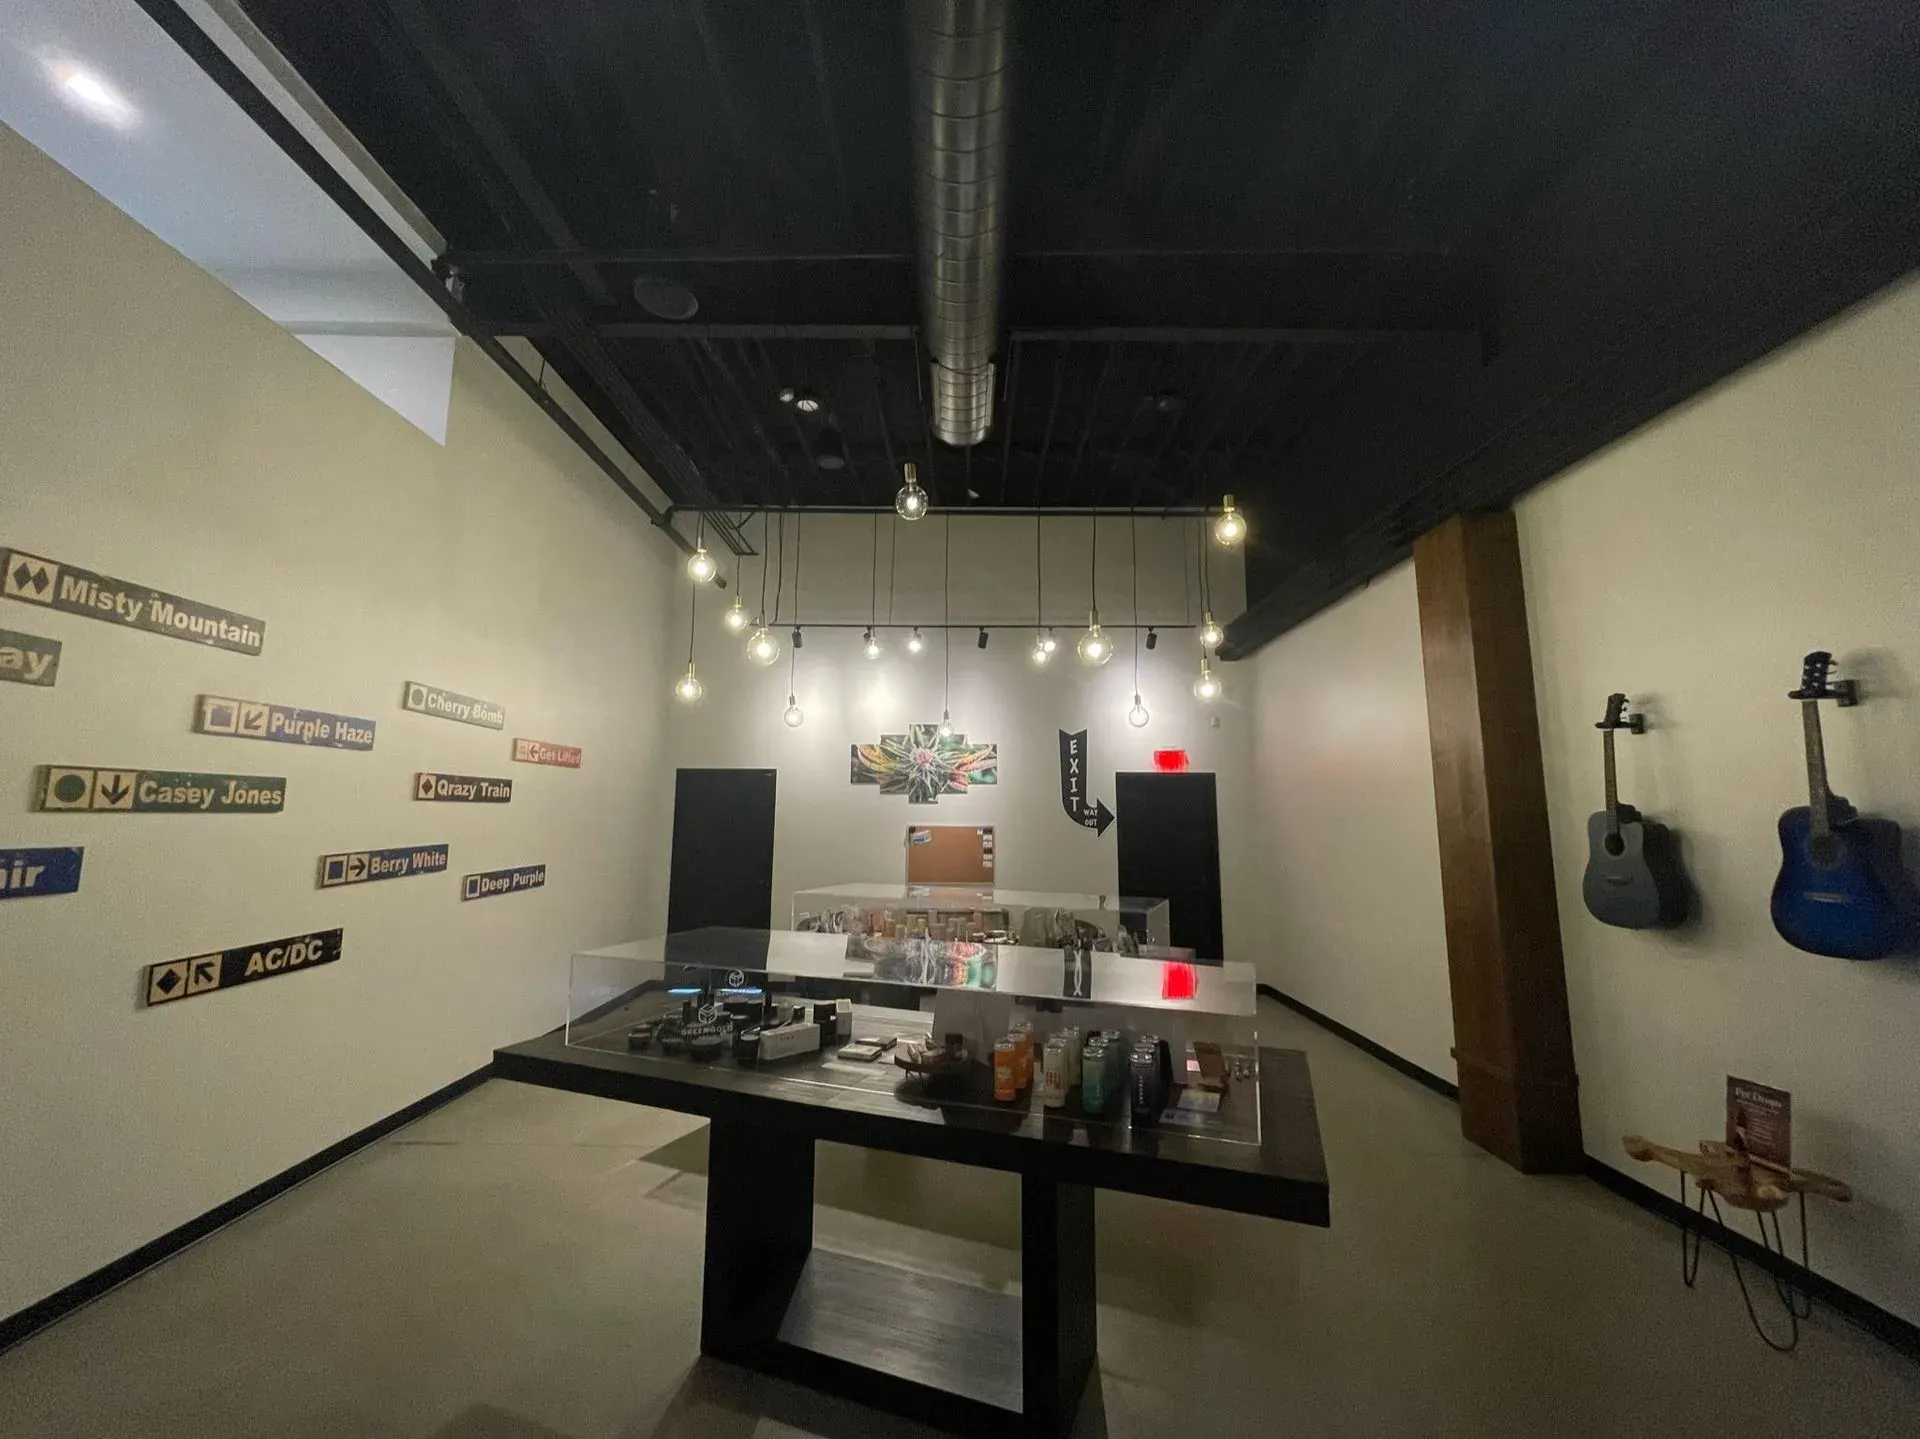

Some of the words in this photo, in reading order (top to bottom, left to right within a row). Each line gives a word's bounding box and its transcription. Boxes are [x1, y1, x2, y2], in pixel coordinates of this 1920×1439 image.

[60, 576, 144, 622] Misty
[151, 600, 261, 648] Mountain
[428, 692, 470, 719] Cherry
[473, 706, 504, 724] Bomb
[270, 711, 331, 745] Purple
[335, 720, 373, 745] Haze
[538, 747, 556, 761] Get
[437, 778, 477, 800] Qrazy
[481, 781, 510, 798] Train
[1069, 739, 1080, 813] EXIT
[138, 780, 215, 810] Casey
[221, 780, 283, 806] Jones
[1083, 808, 1098, 817] WAY
[1084, 818, 1098, 827] OUT
[370, 856, 409, 876] Berry
[412, 850, 447, 868] White
[480, 876, 510, 893] Deep
[512, 869, 545, 889] Purple
[244, 939, 323, 977] AC/DC
